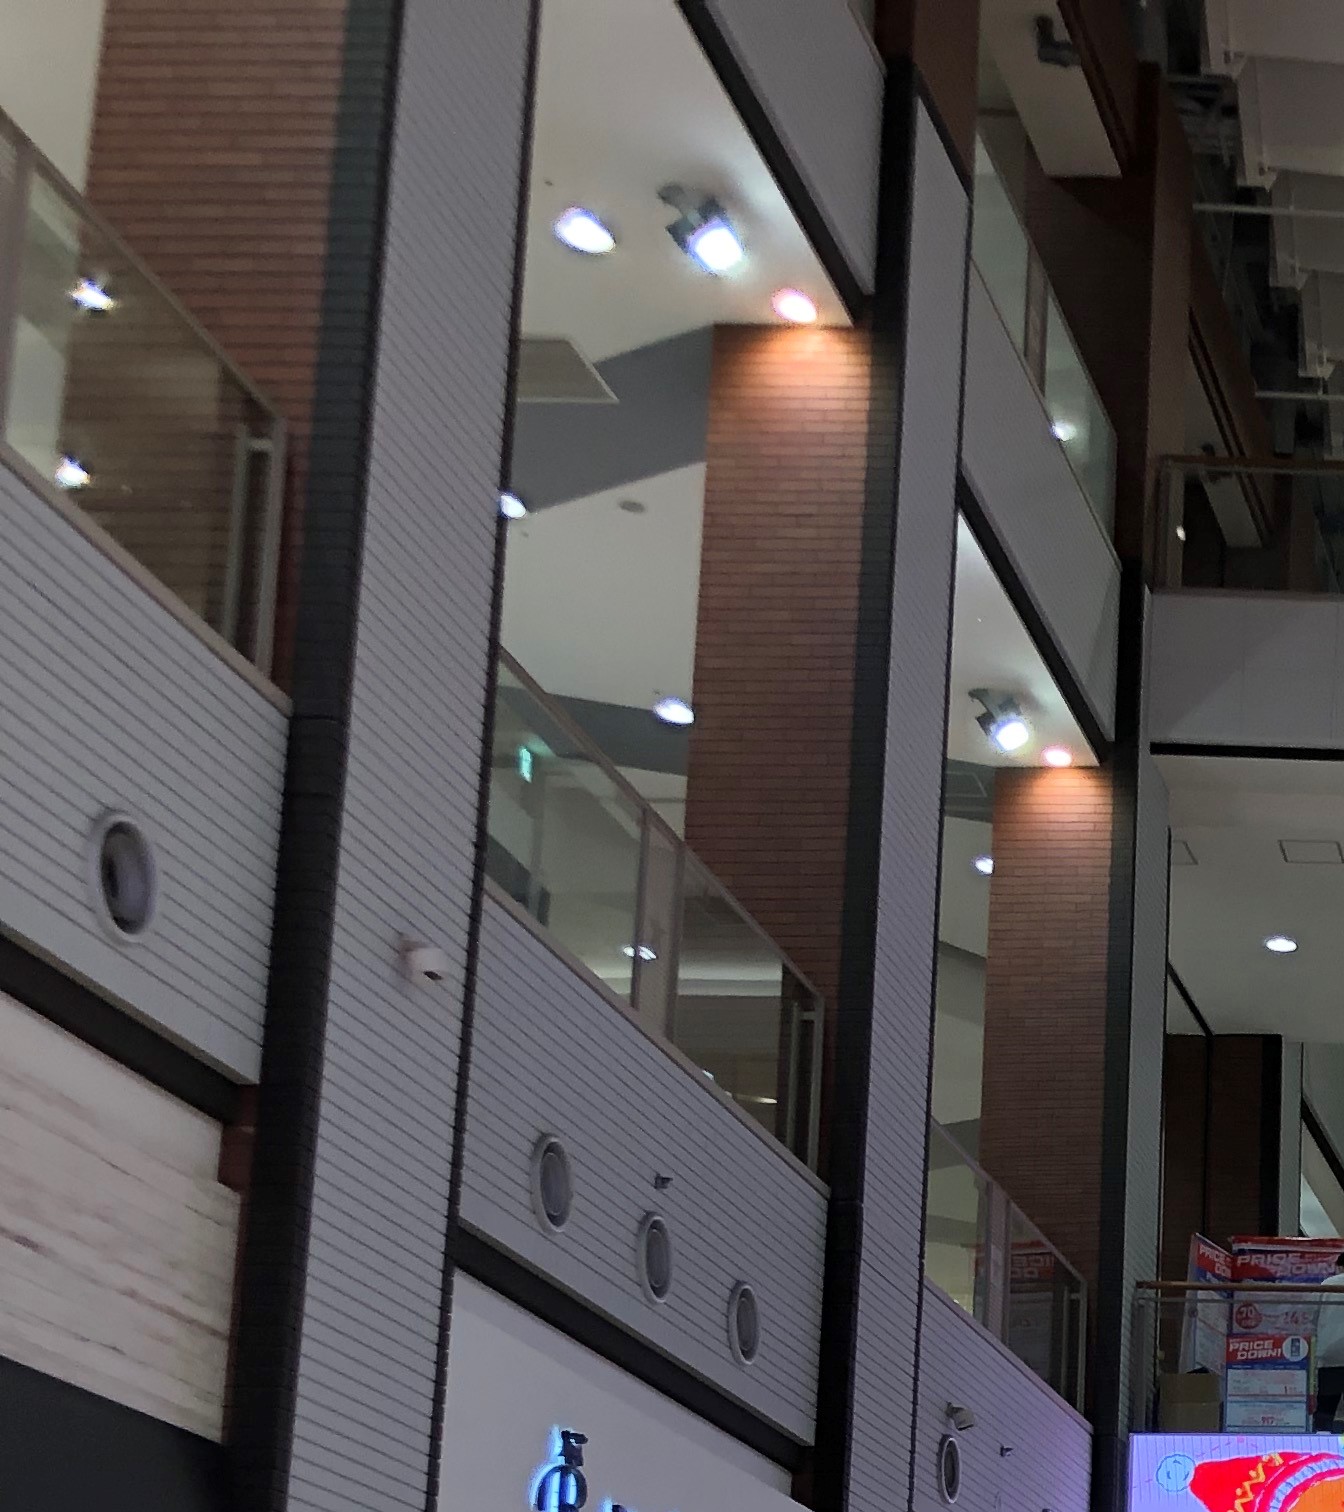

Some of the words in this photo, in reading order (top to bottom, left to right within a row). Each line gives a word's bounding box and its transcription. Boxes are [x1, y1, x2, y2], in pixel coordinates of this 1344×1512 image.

[1236, 1252, 1301, 1267] PRICE
[1229, 1339, 1274, 1352] PRICE
[1236, 1348, 1283, 1360] DOWN!
